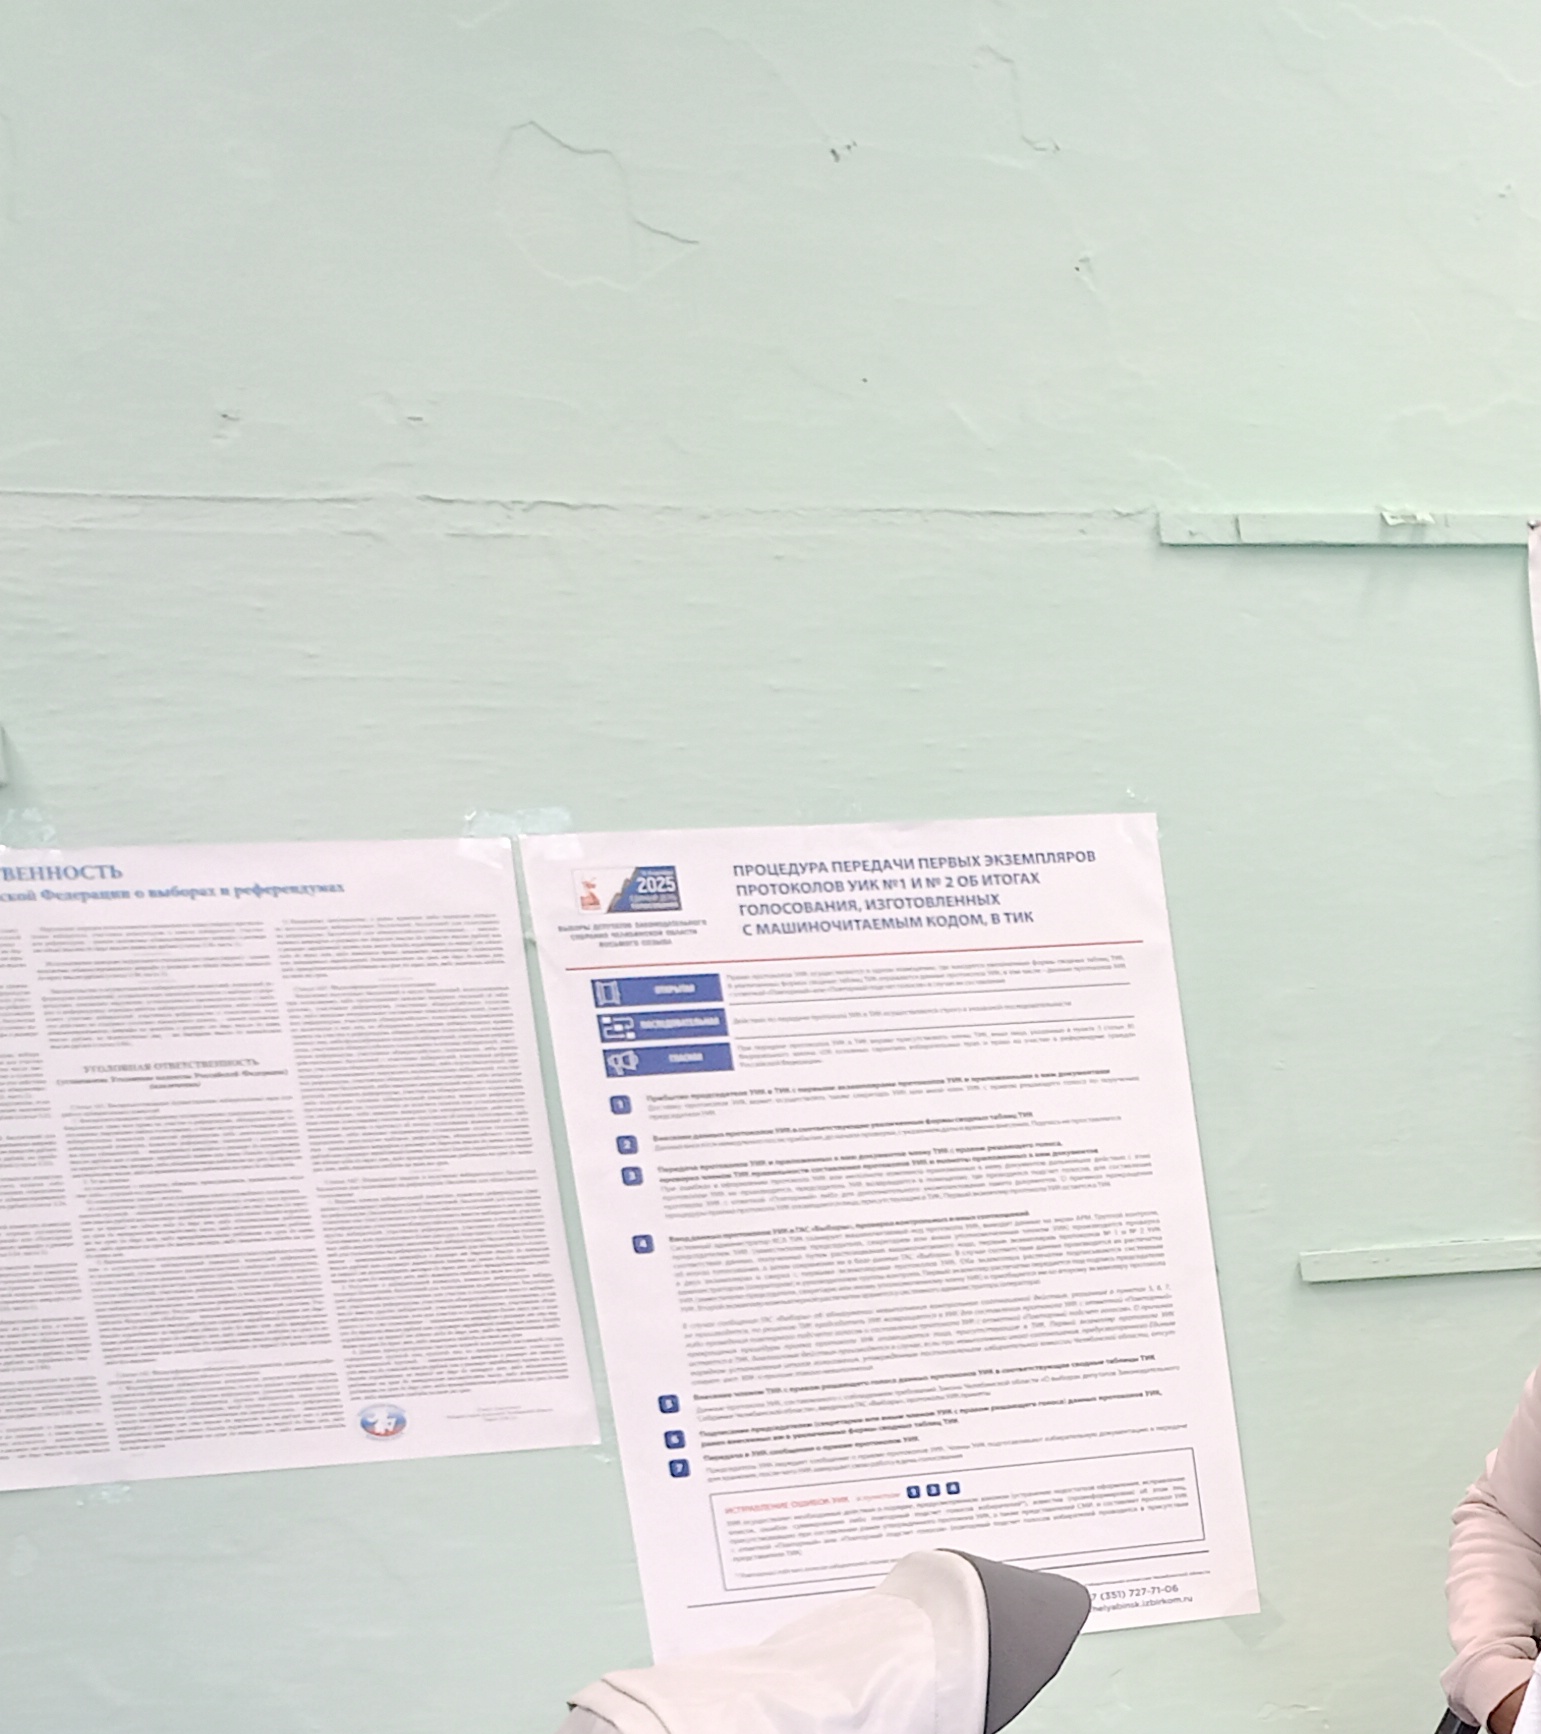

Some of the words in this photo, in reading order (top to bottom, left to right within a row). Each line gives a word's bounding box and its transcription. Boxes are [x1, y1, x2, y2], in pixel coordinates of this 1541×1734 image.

[0, 865, 123, 880] ВЕННОСТЬ
[733, 860, 829, 877] ПРОЦЕДУРА
[832, 857, 915, 874] ПЕРЕДАЧИ
[918, 854, 981, 871] ПЕРВЫХ
[984, 850, 1096, 867] ЭКЗЕМПЛЯРОВ
[636, 876, 677, 893] 2025
[736, 880, 845, 897] ПРОТОКОЛОВ
[847, 879, 880, 893] УИК
[911, 876, 923, 889] И
[945, 876, 955, 888] 2
[957, 875, 979, 888] ОБ
[981, 871, 1041, 887] ИТОГАХ
[739, 898, 863, 917] ГОЛОСОВАНИЯ,
[866, 893, 1001, 912] ИЗГОТОВЛЕННЫХ
[742, 923, 753, 936] С
[756, 916, 923, 935] МАШИНОЧИТАЕМЫМ
[926, 912, 988, 928] КОДОМ,
[991, 912, 1001, 925] В
[1004, 911, 1034, 924] ТИК
[1129, 1584, 1179, 1598] 727-71-06
